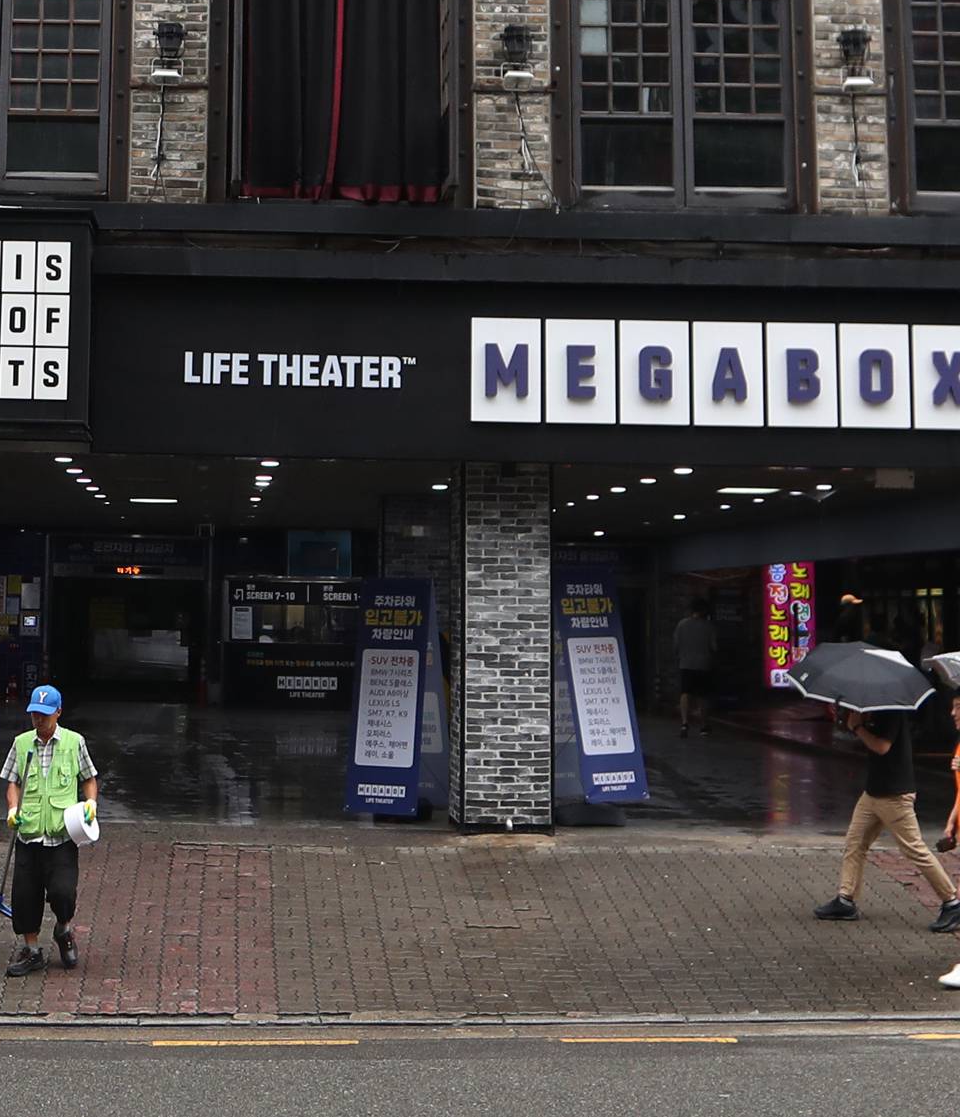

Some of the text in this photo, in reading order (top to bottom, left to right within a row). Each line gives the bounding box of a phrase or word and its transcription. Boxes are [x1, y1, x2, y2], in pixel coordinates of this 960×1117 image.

[15, 254, 62, 281] IS
[9, 306, 60, 333] OF
[184, 350, 249, 385] LIFE
[484, 342, 960, 407] MEGABOX
[246, 592, 296, 601] SCREEN 7-10
[323, 592, 349, 601] SCREEN
[374, 595, 417, 607] 주차타워
[560, 597, 615, 614] 입고불가
[365, 609, 423, 626] 입고불가
[371, 628, 414, 640] 차량안내
[370, 657, 389, 665] SUV
[39, 691, 49, 704] Y
[368, 699, 391, 707] LEXUS
